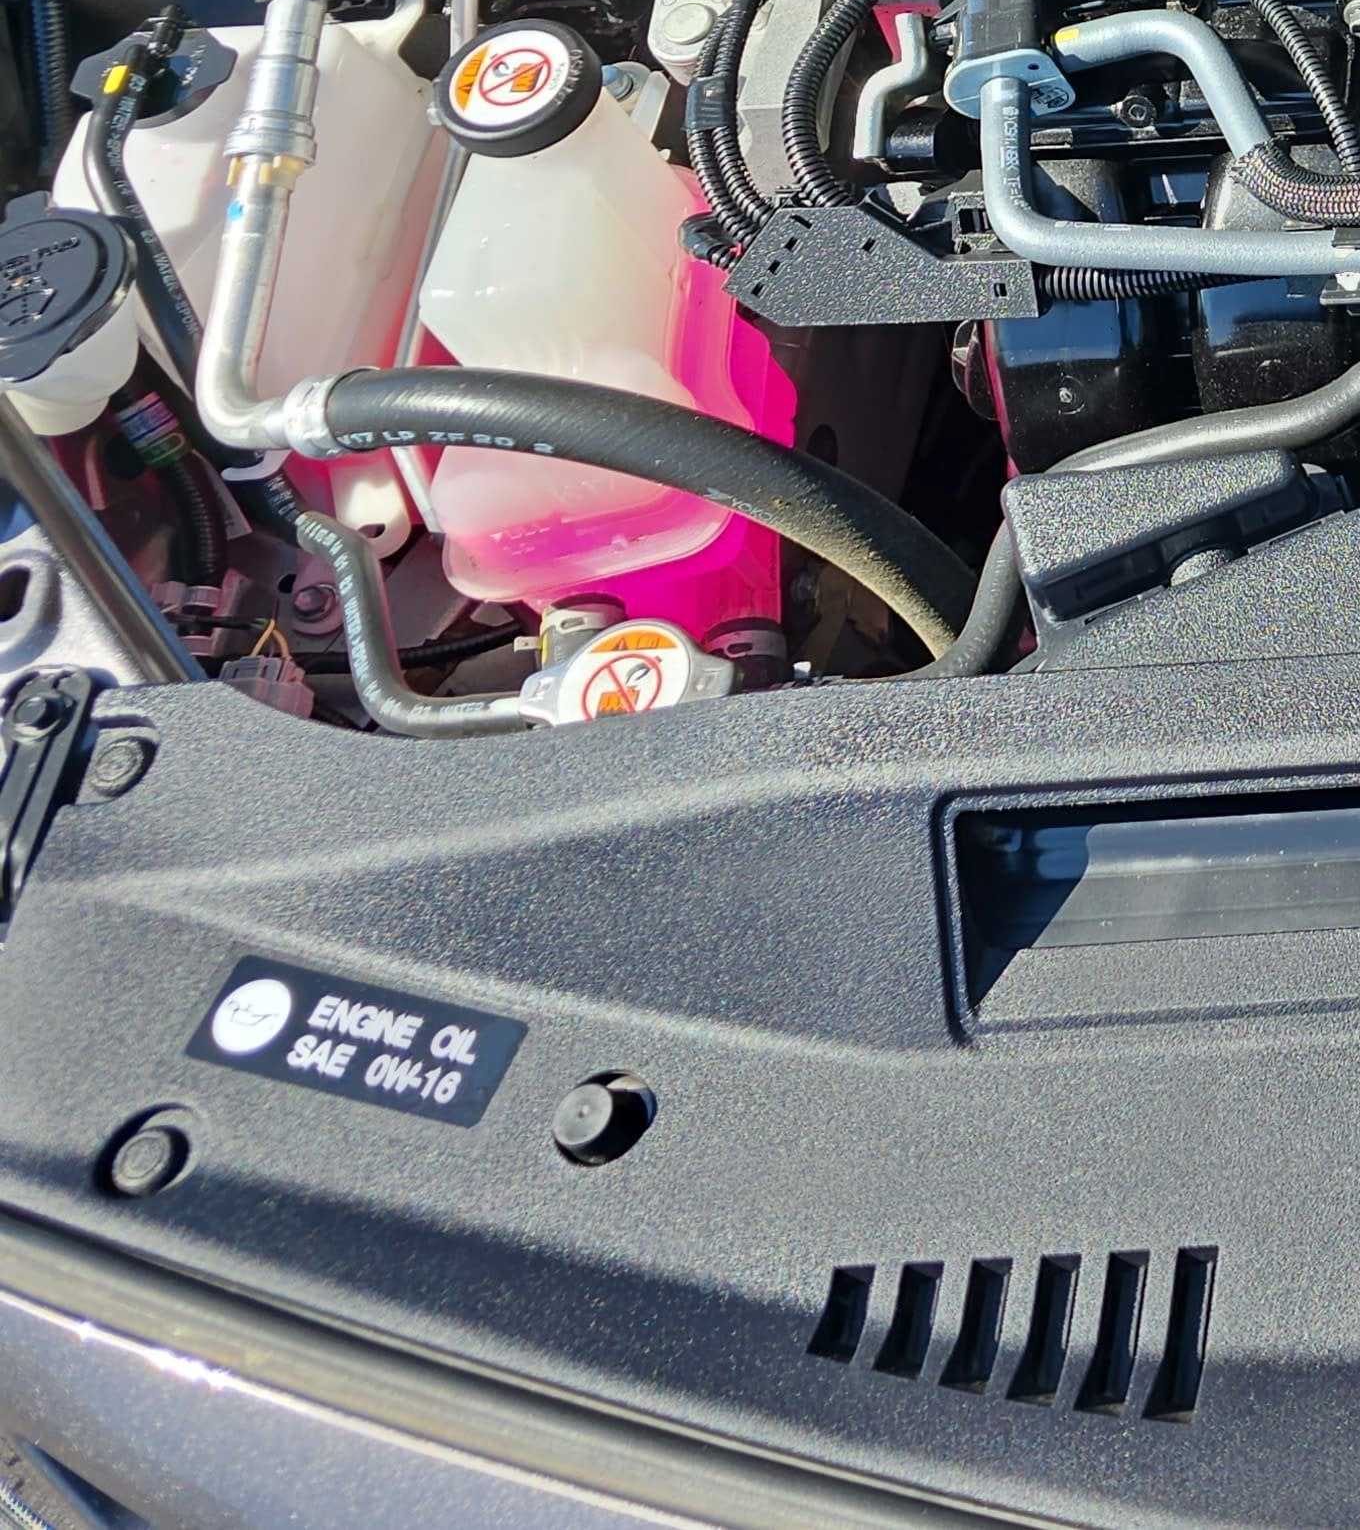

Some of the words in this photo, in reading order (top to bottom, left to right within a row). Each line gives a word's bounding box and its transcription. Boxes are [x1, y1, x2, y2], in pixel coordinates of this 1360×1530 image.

[307, 994, 424, 1049] ENGINE
[430, 1025, 477, 1065] OIL
[286, 1034, 358, 1078] SAE
[364, 1054, 462, 1104] 0W-16
